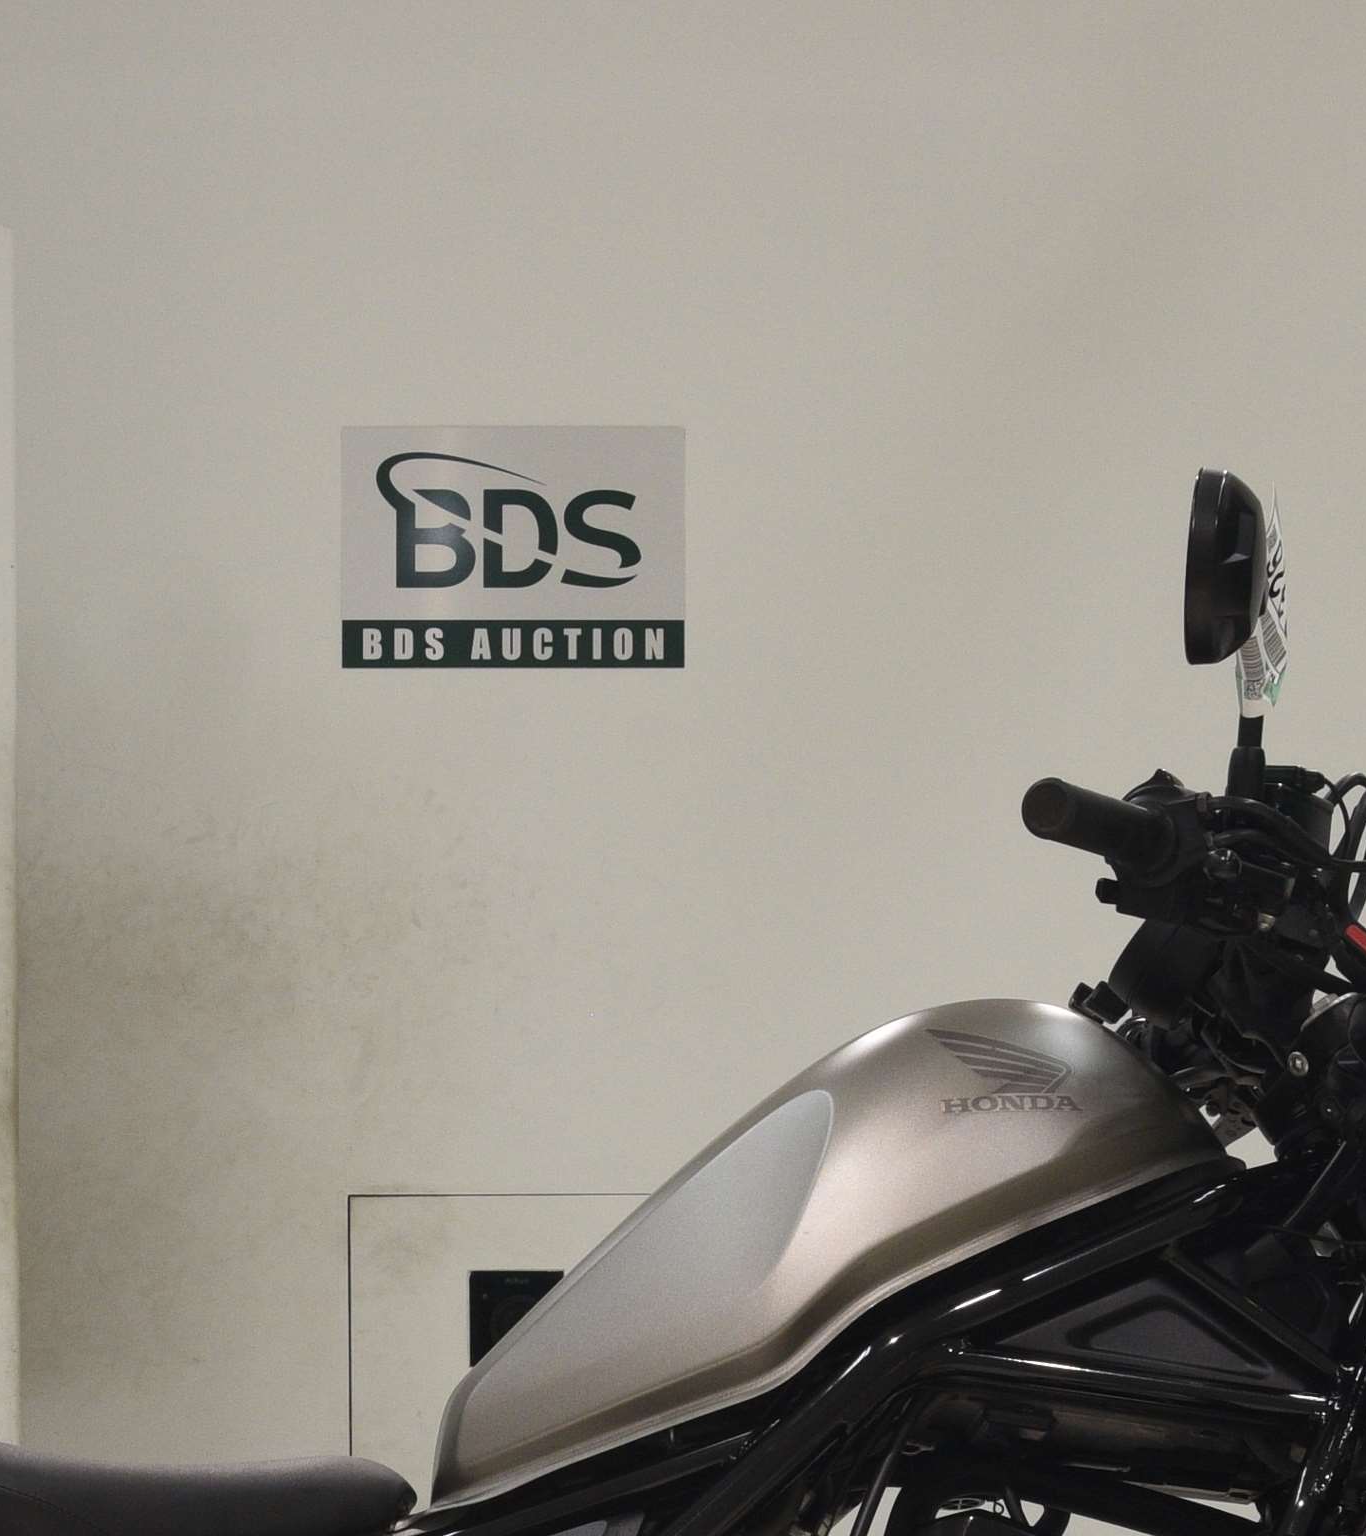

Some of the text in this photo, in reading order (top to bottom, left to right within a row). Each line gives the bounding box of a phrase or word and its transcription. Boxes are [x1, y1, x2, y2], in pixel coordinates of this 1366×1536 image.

[376, 452, 642, 588] BDS
[362, 628, 665, 660] BDS AUCTION
[942, 1096, 1083, 1113] HONDA
